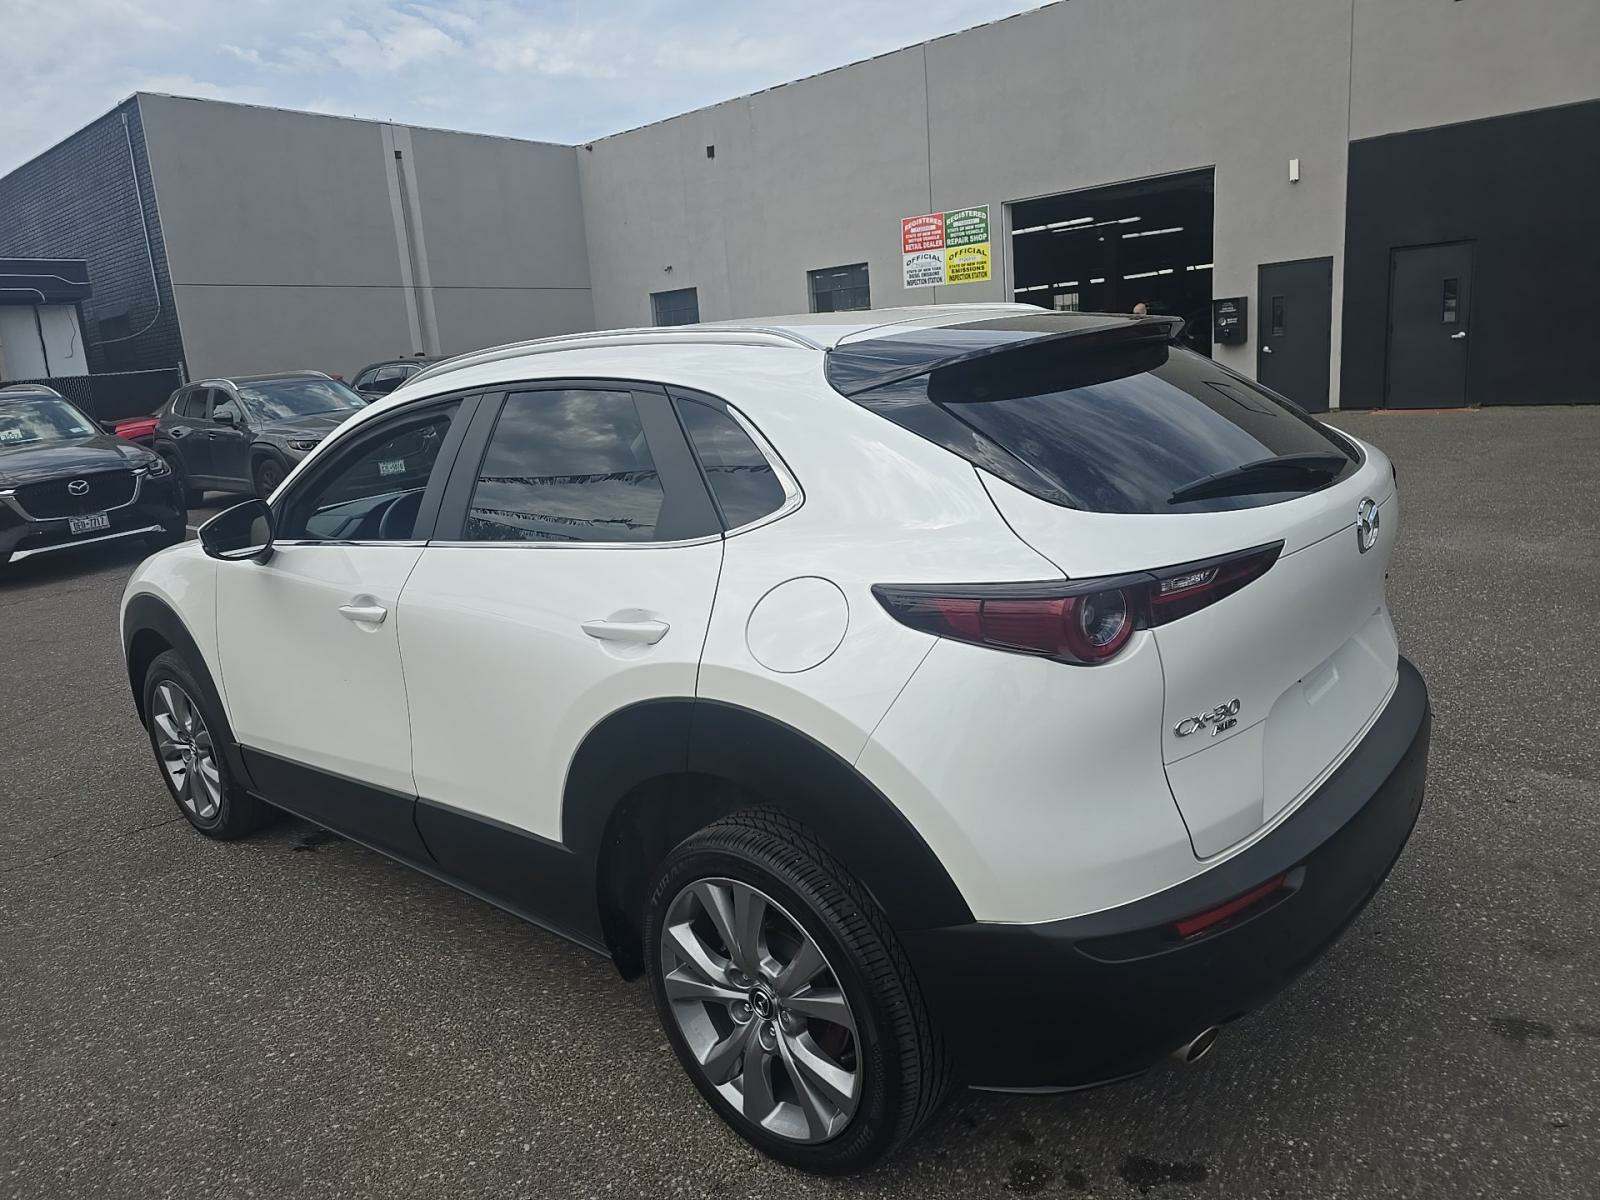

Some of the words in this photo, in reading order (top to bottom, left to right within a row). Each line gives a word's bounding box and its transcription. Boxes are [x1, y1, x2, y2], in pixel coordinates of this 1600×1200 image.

[947, 211, 986, 225] REGISTERED
[905, 218, 942, 231] REGISTERED
[905, 243, 922, 251] RETAIL
[923, 240, 943, 248] DEALER
[947, 237, 969, 246] REPAIR
[949, 248, 987, 260] OFFICIAL
[907, 254, 942, 266] OFFICIAL
[951, 265, 984, 273] EMISSIONS
[949, 273, 971, 281] INSPECTION
[972, 271, 987, 279] STATION
[906, 278, 927, 286] INSPECTION
[1173, 698, 1241, 737] CX-30
